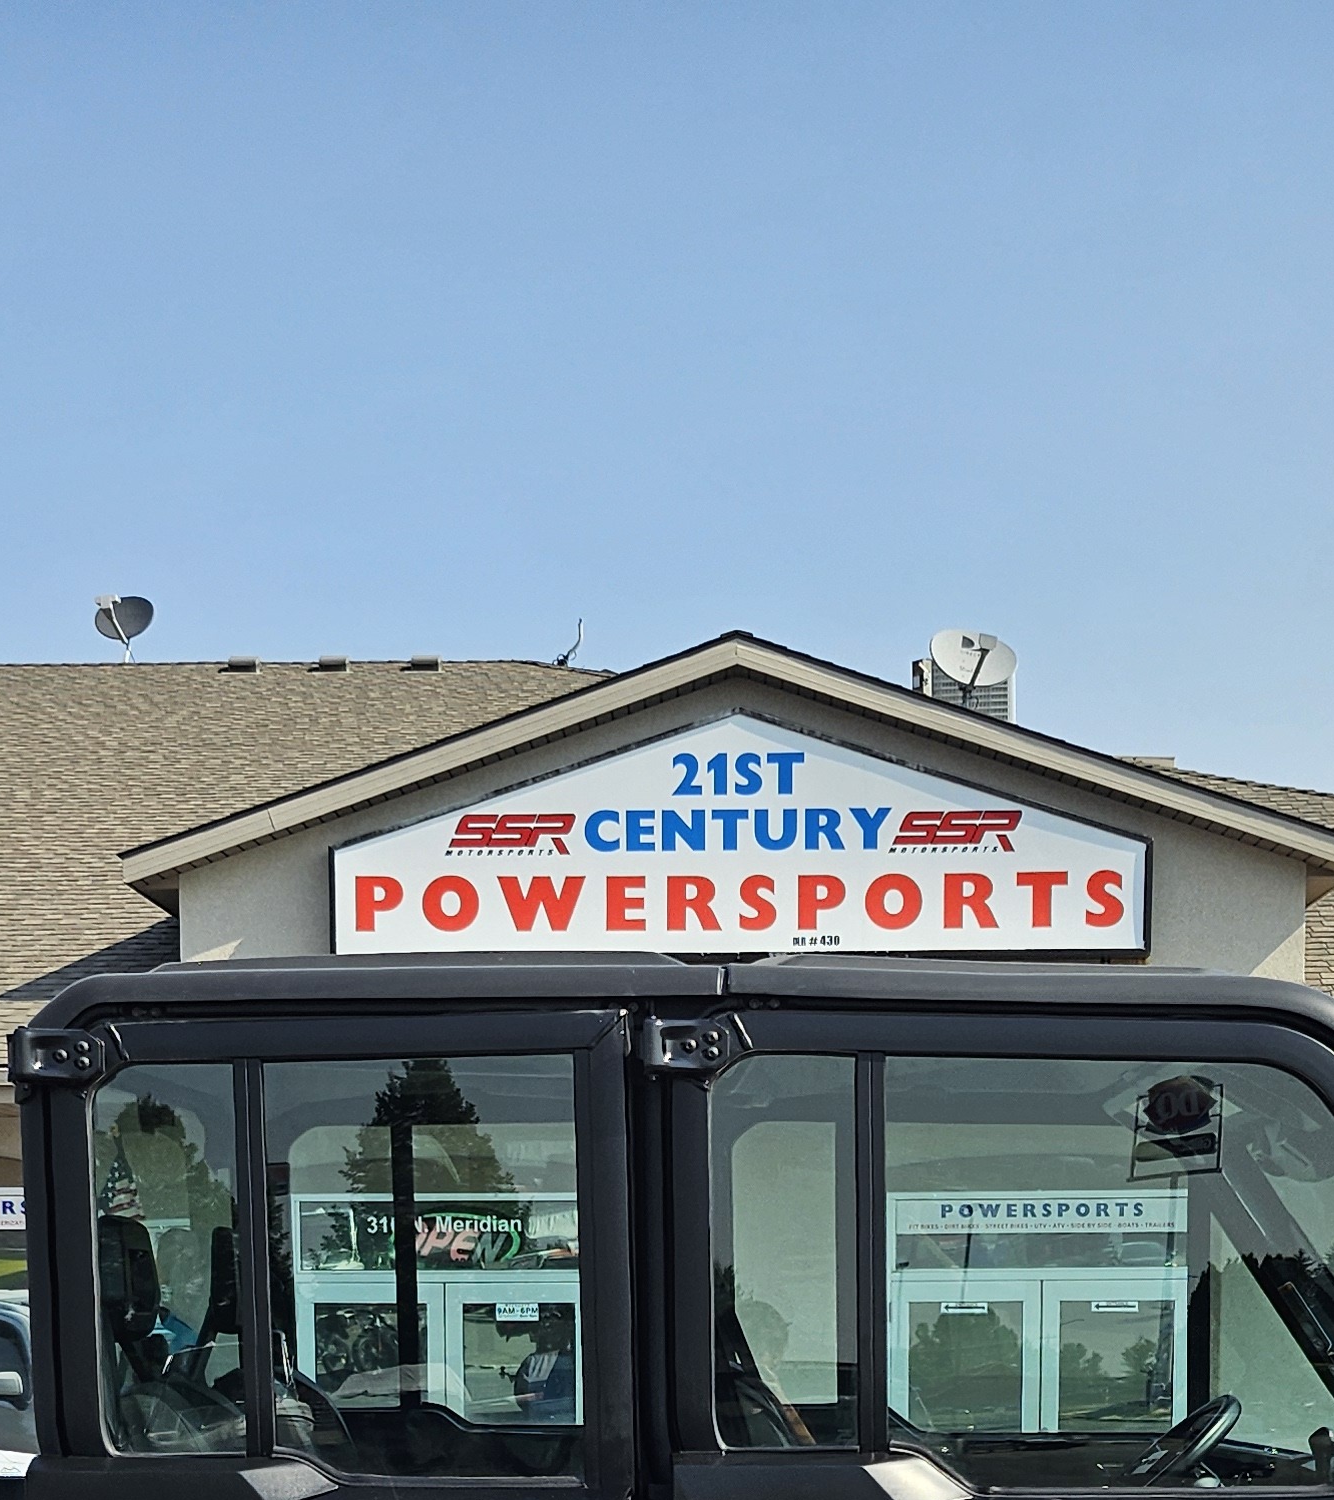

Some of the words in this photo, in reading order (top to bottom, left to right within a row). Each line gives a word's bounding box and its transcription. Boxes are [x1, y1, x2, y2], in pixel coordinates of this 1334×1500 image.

[671, 752, 806, 796] 21ST
[449, 814, 576, 856] SSR
[584, 807, 892, 853] CENTURY
[888, 846, 999, 854] MOTORSPORTS
[892, 810, 1022, 852] SSR
[354, 870, 1126, 932] POWERSPORTS
[809, 937, 818, 946] #
[820, 936, 840, 946] 430
[436, 1215, 522, 1233] Meridian
[940, 1202, 1144, 1219] POWERSPORTS
